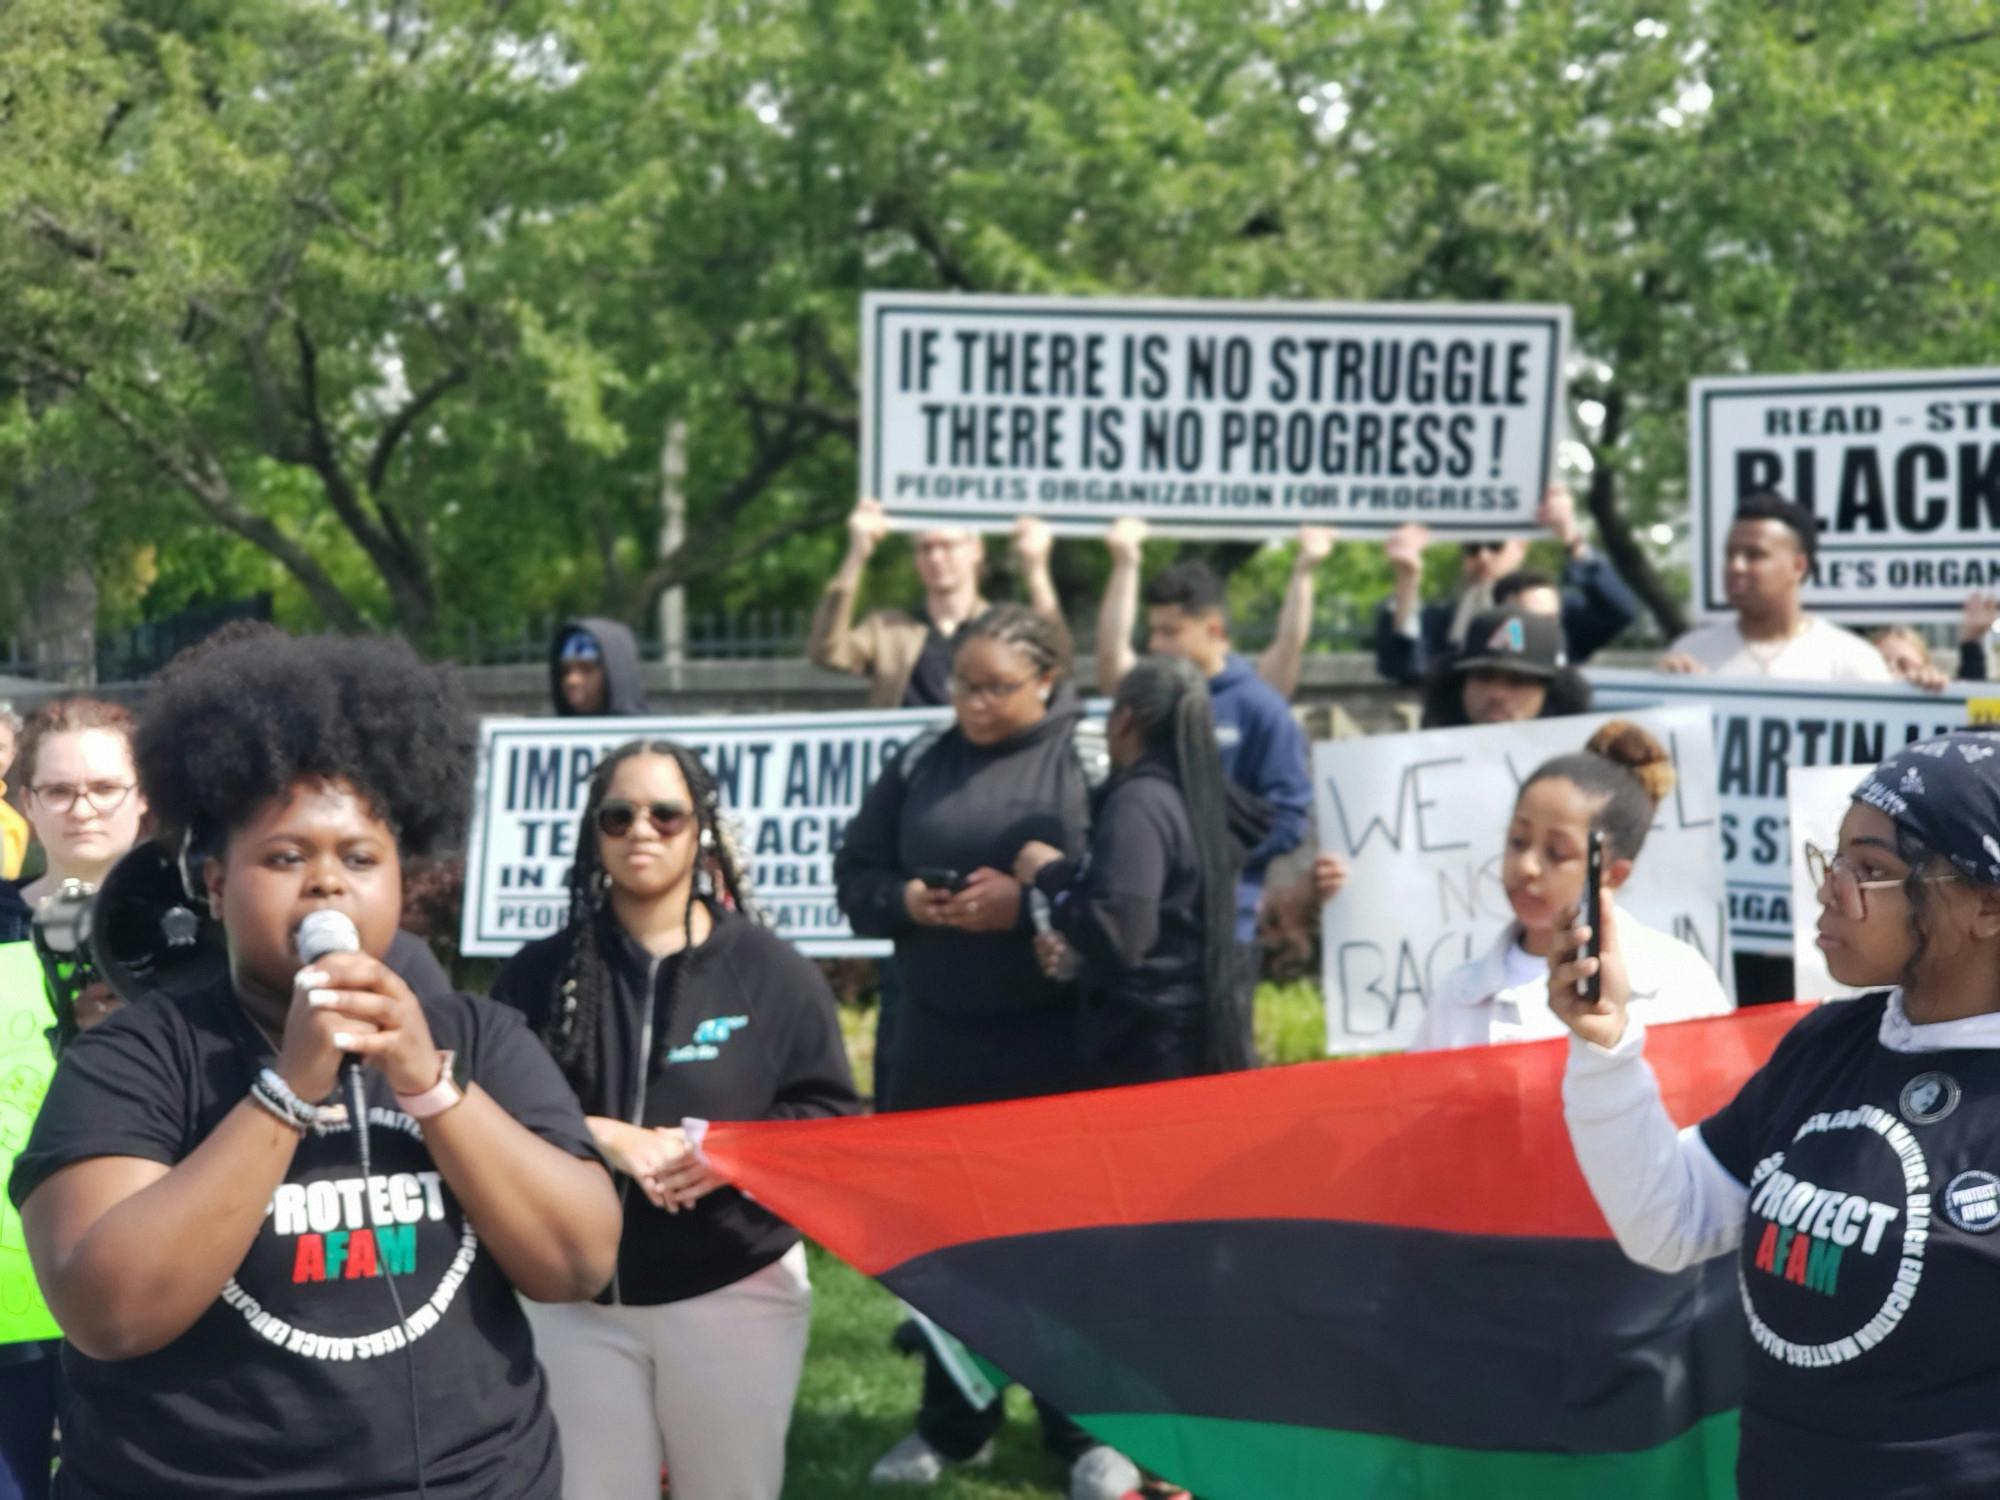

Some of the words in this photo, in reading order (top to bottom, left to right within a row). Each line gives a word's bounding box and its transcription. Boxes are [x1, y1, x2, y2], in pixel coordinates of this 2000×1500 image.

[901, 328, 940, 393] IF
[955, 329, 1105, 398] THERE
[1123, 333, 1169, 400] IS
[1187, 335, 1253, 403] NO
[1269, 335, 1530, 406] STRUGGLE
[922, 402, 1064, 468] THERE
[1081, 405, 1125, 471] IS
[1140, 407, 1203, 474] NO
[1220, 410, 1474, 479] PROGRESS
[1490, 415, 1505, 479] !
[1765, 405, 1882, 437] READ
[896, 474, 1028, 500] PEOPLES
[1038, 477, 1272, 507] ORGANIZATION
[1283, 484, 1340, 508] FOR
[1349, 484, 1519, 511] PROGRESS
[1328, 757, 1471, 859] WE
[502, 865, 545, 888] IN
[265, 1170, 445, 1236] ROTECT
[1751, 1169, 1899, 1256] PROTECT
[1903, 1193, 1931, 1257] BLACK
[292, 1223, 416, 1285] AFAM
[1755, 1221, 1845, 1297] AFAM
[1853, 1257, 1924, 1351] EDUCATION
